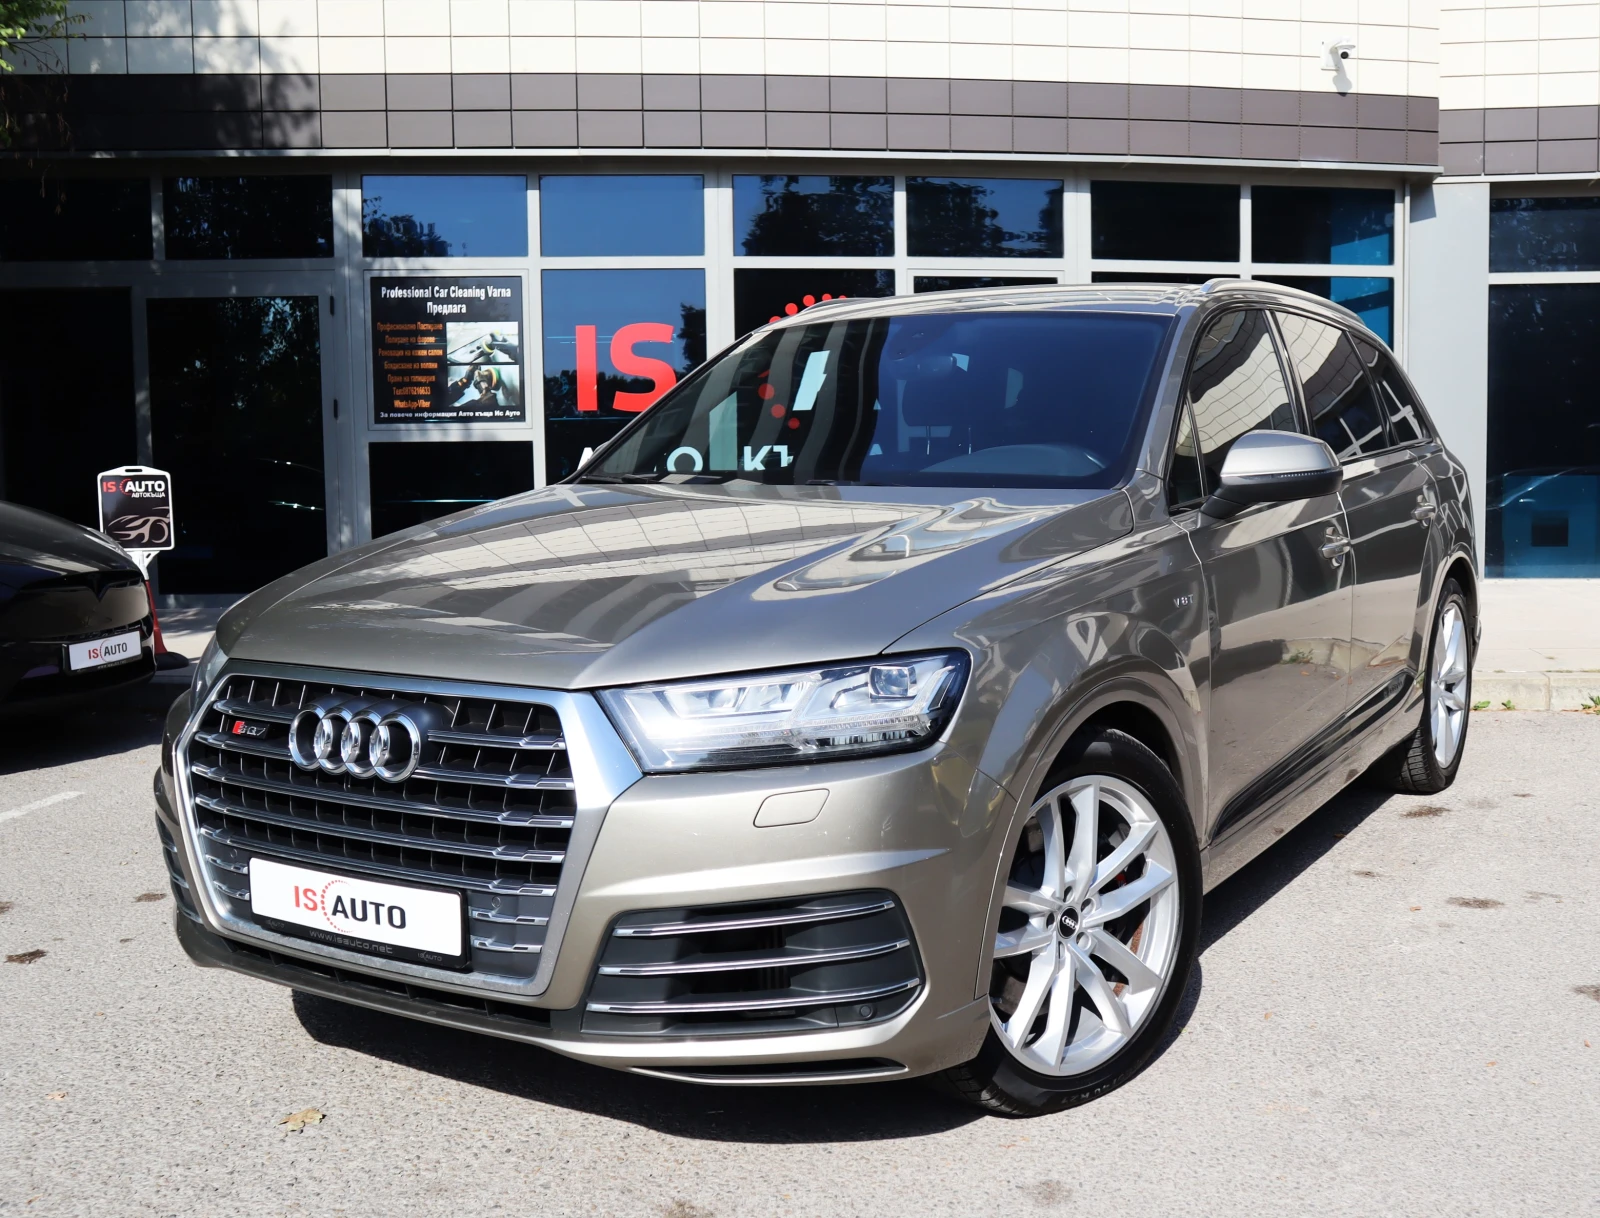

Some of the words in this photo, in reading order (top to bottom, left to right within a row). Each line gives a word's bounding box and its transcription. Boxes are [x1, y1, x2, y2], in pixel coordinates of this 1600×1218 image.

[381, 286, 432, 299] Professional
[434, 286, 448, 298] Car
[450, 285, 485, 300] Cleaning
[487, 286, 512, 298] Varna
[427, 302, 467, 316] Предлага
[575, 322, 677, 412] IS
[390, 412, 413, 420] повече
[414, 411, 457, 421] информация
[475, 411, 493, 419] къща
[505, 410, 521, 419] Ауто
[102, 481, 117, 493] IS
[124, 480, 166, 493] AUTO
[1173, 593, 1194, 608] V8T
[88, 648, 100, 660] IS
[103, 642, 128, 657] AUTO
[232, 720, 266, 736] SQ7
[293, 885, 318, 912] IS
[331, 895, 407, 930] AUTO
[309, 929, 394, 955] www.isauto.net
